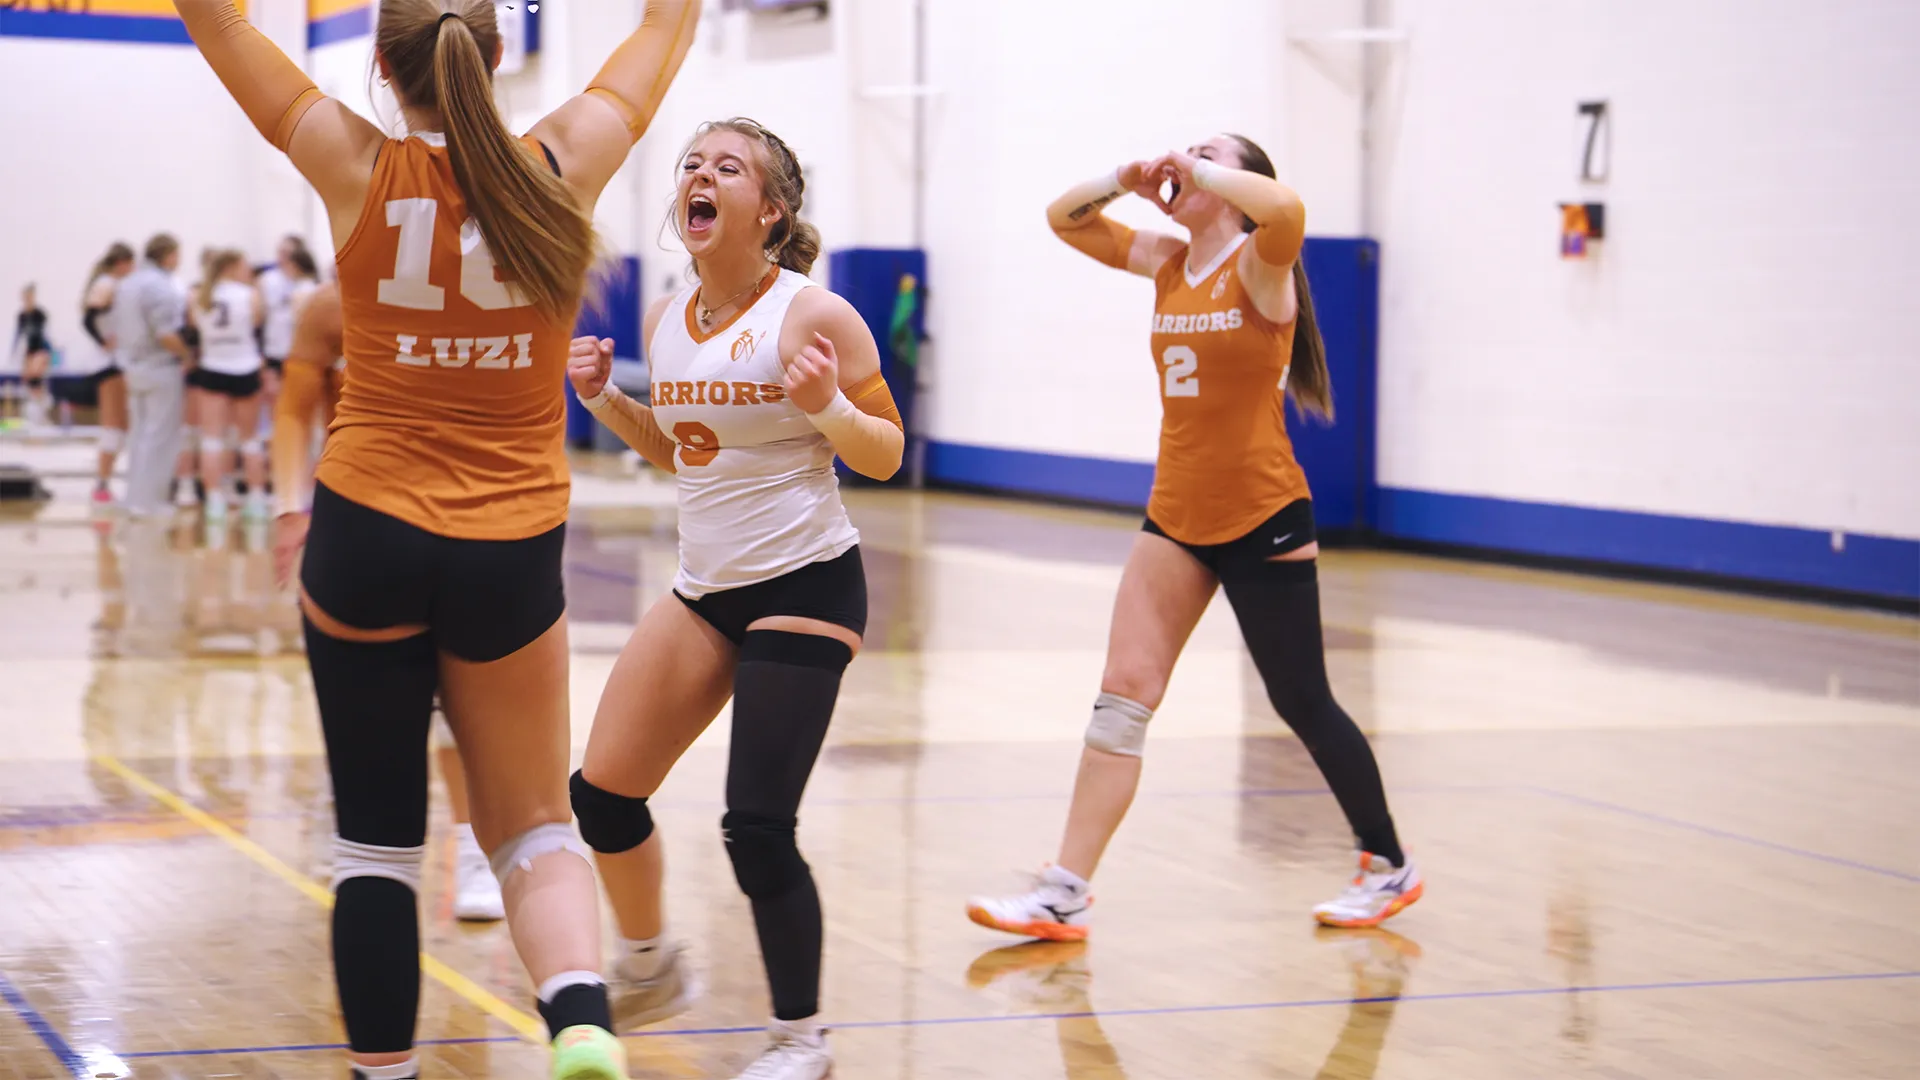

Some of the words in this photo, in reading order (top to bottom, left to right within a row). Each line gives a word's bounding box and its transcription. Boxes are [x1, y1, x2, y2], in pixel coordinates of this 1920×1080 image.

[1577, 100, 1607, 179] 7
[395, 332, 533, 370] LUZI
[1163, 345, 1199, 397] 2
